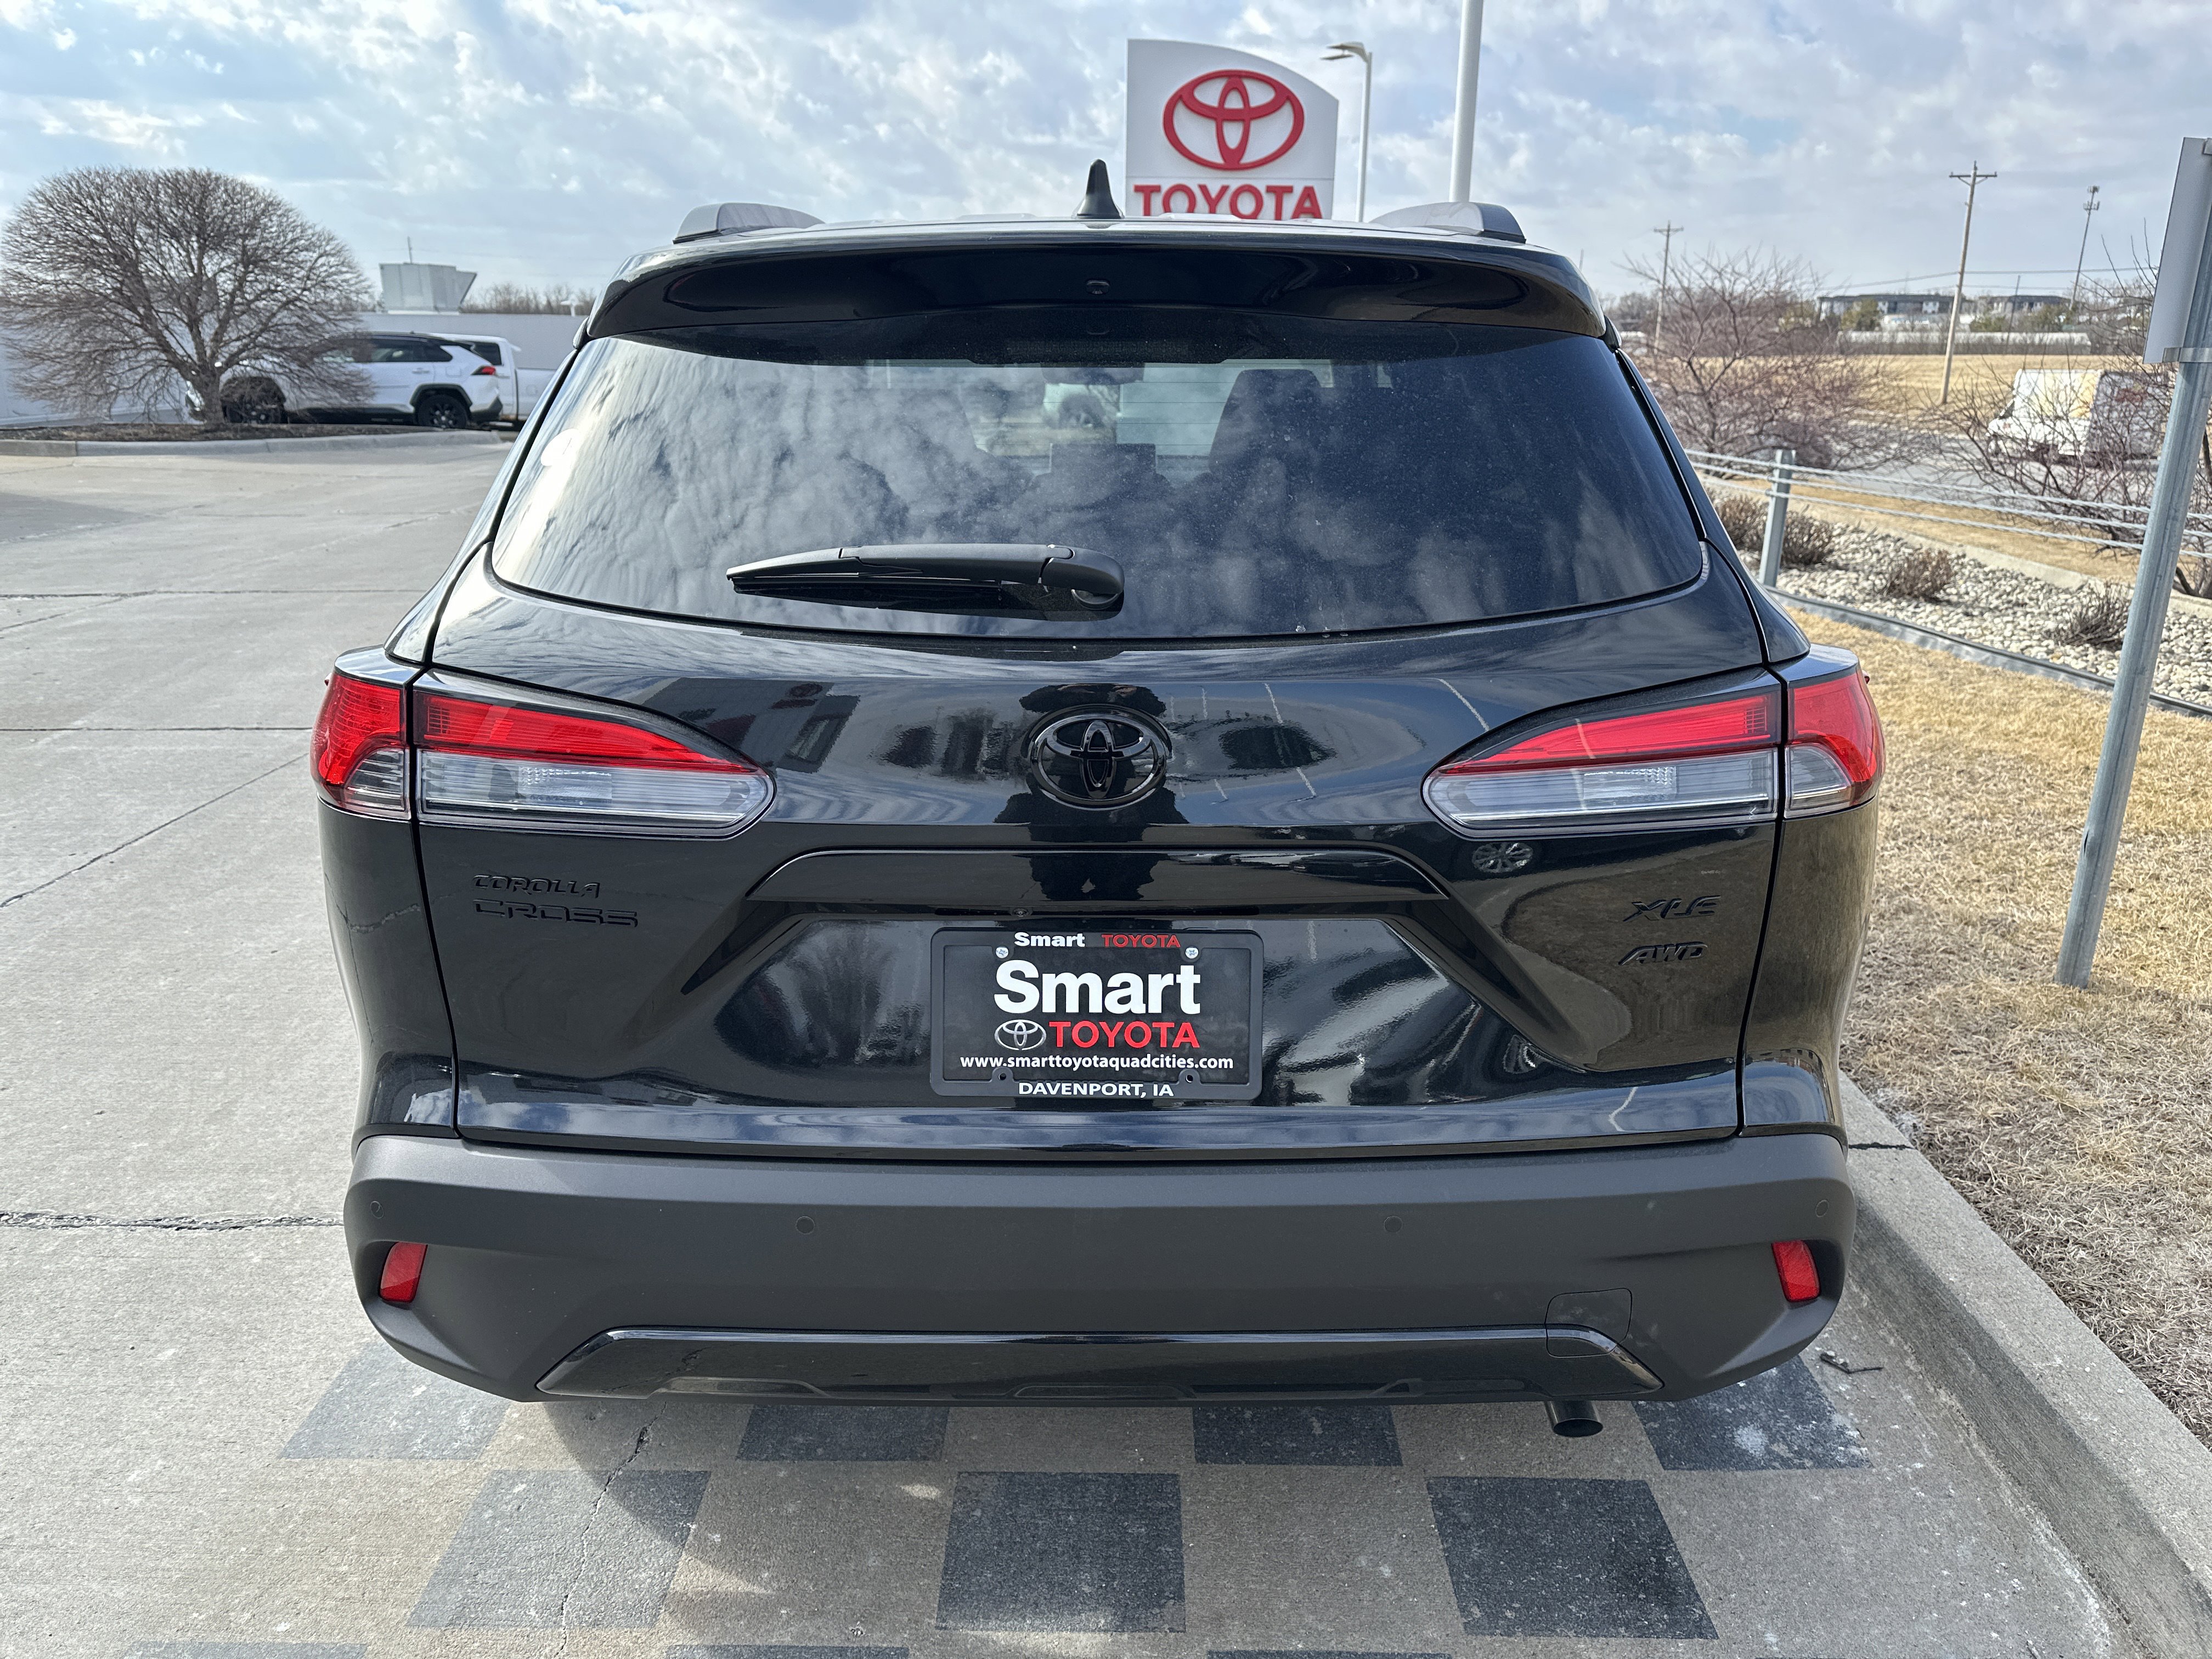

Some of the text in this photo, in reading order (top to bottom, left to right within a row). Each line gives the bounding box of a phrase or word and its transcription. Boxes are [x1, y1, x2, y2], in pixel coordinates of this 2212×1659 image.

[1133, 184, 1323, 221] TOYOTA
[473, 874, 600, 898] COROLLA
[472, 899, 638, 928] CROSS
[1623, 895, 1721, 922] XLE
[1014, 932, 1181, 948] Smart TOYOTA
[1618, 941, 1708, 966] AWD
[994, 959, 1201, 1014] Smart
[1049, 1020, 1200, 1048] TOYOTA
[960, 1054, 1234, 1070] www.smarttoyotaquadcities.com
[1019, 1082, 1174, 1098] DAVENPORT, IA
